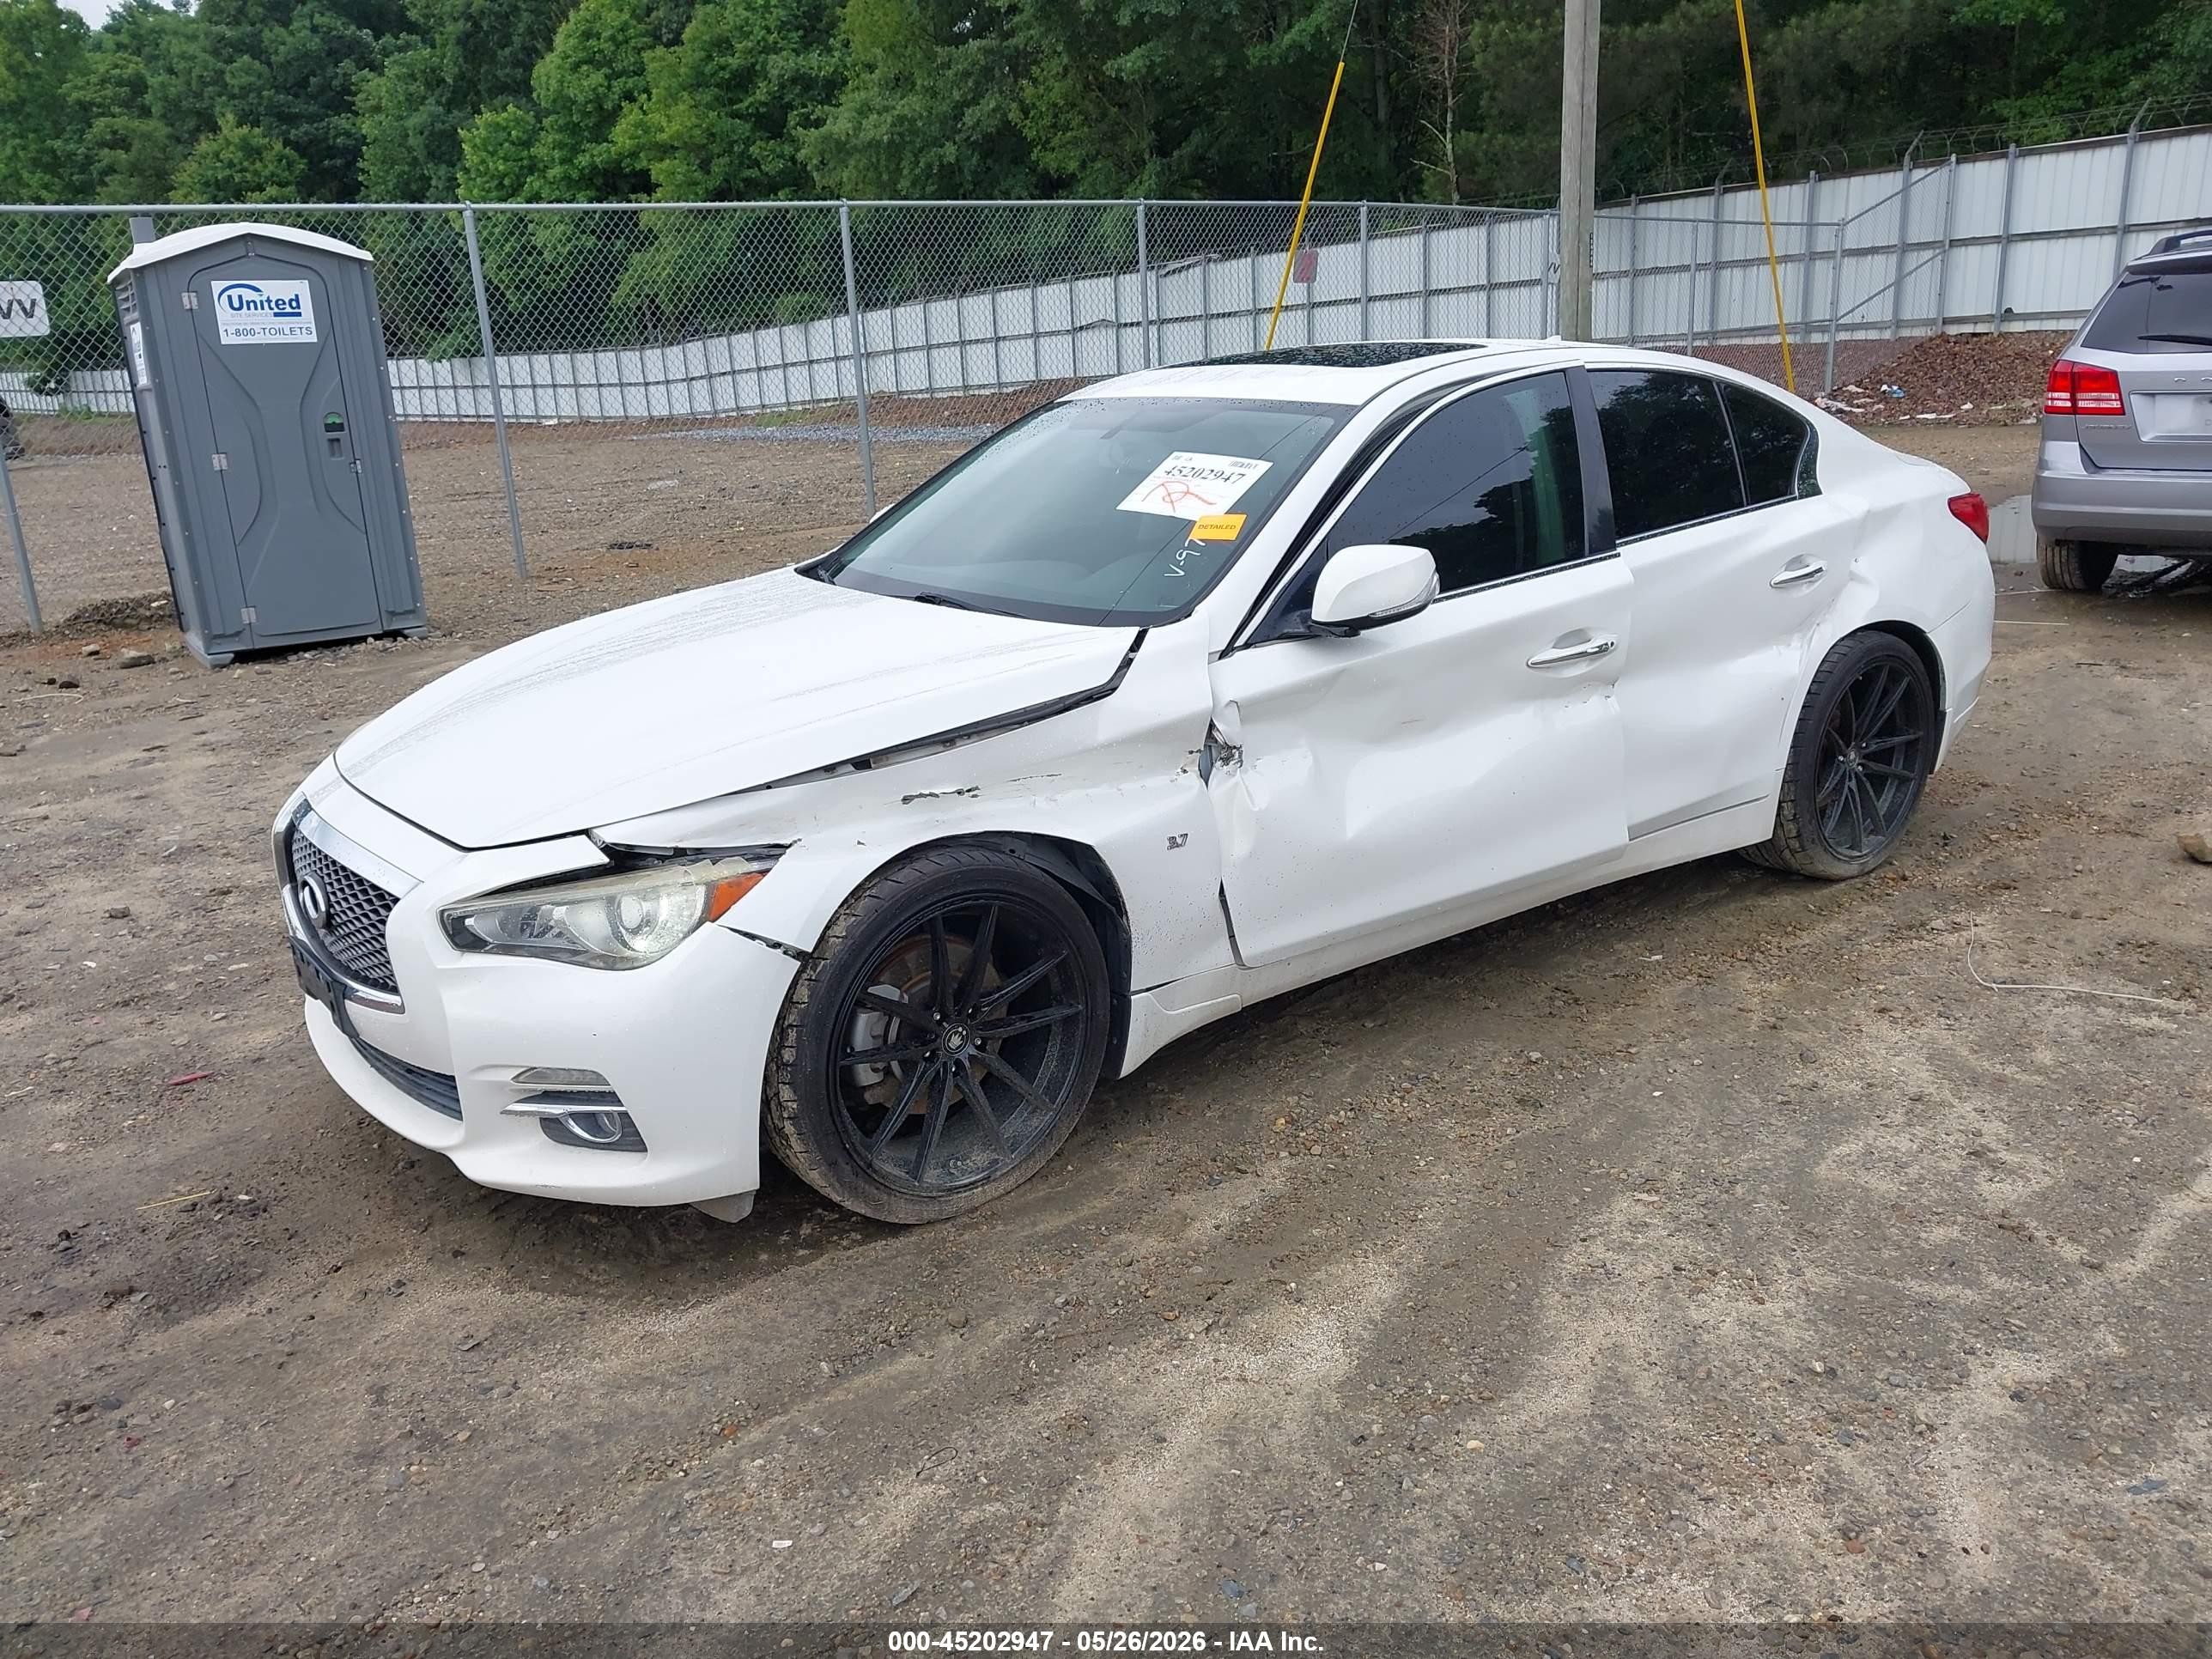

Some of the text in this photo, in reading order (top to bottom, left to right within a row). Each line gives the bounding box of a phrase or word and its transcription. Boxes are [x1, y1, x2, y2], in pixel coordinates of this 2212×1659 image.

[227, 294, 301, 311] United
[223, 326, 313, 337] 1-800-TOILETS
[1164, 465, 1246, 484] 45202947
